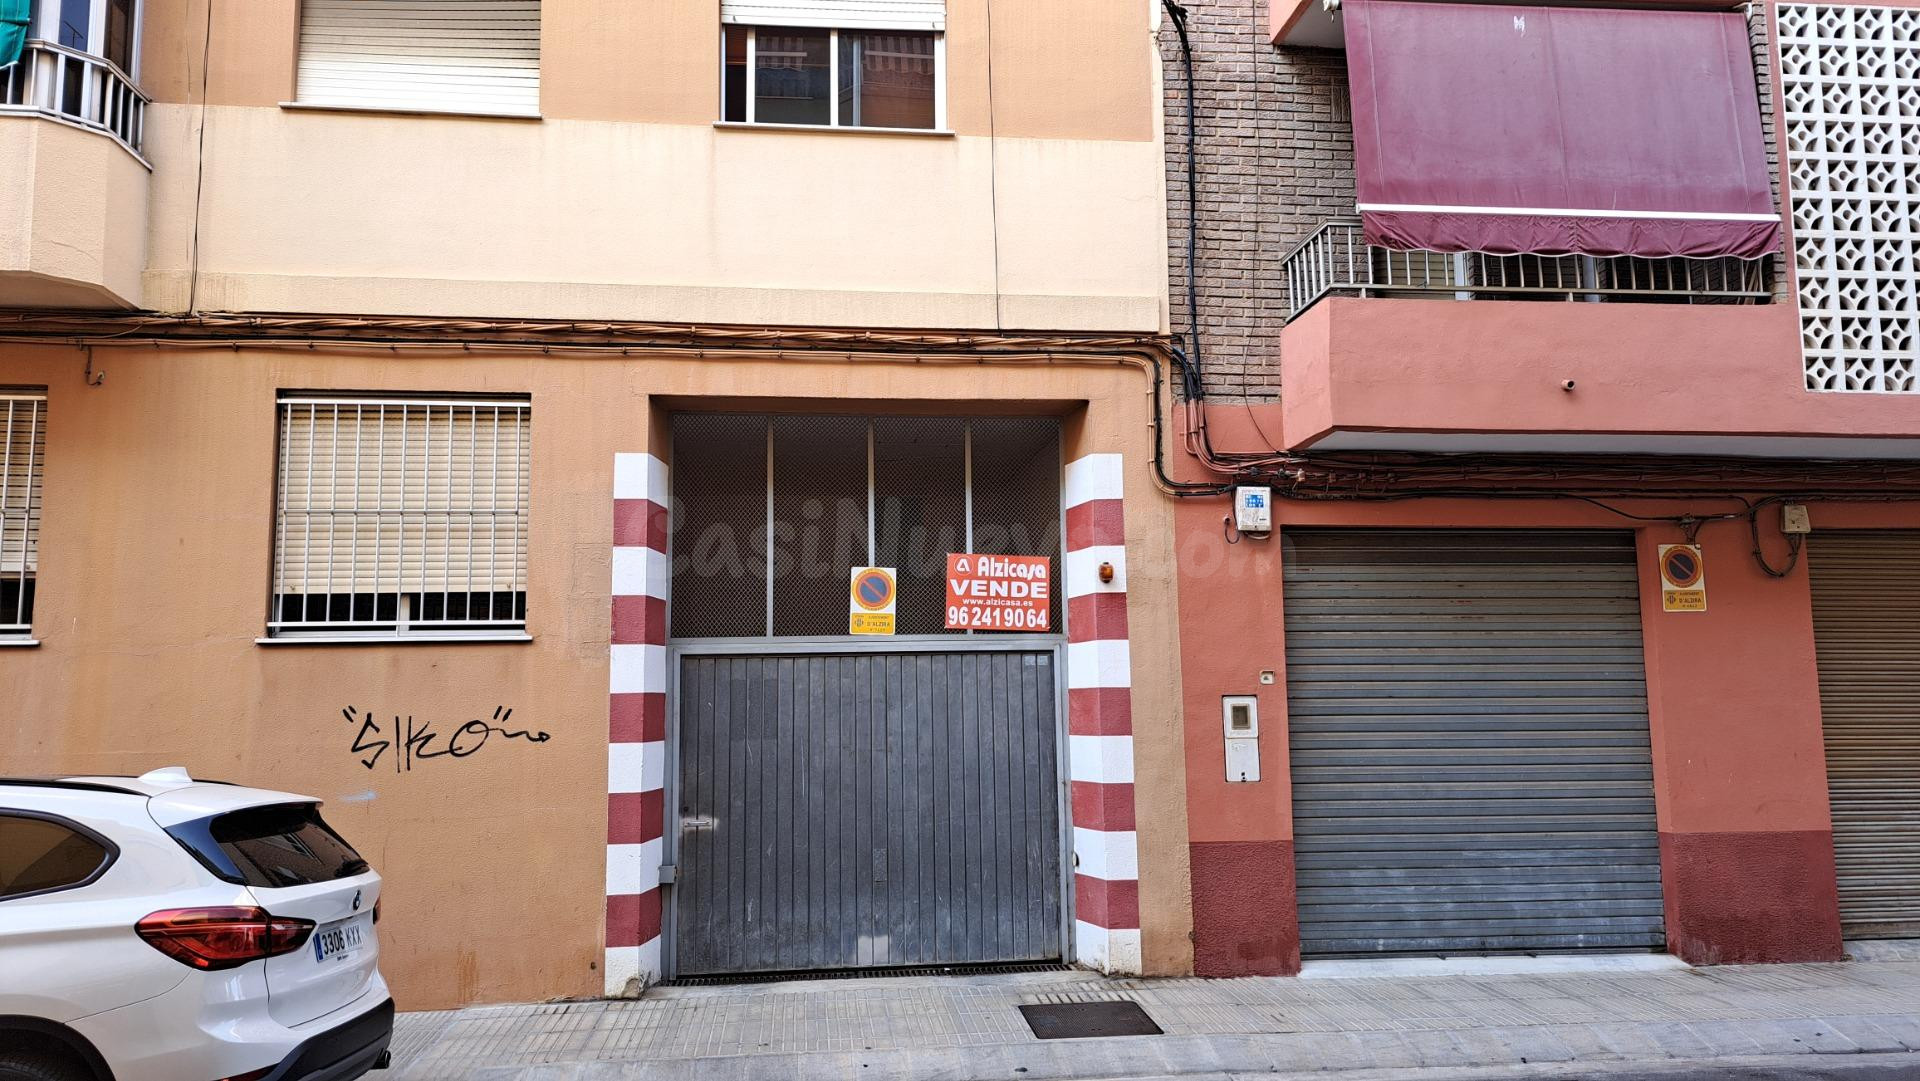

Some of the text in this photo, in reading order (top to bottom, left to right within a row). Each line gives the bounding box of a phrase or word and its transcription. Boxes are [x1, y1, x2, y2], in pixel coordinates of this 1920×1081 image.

[977, 556, 1047, 580] Alzicasa
[950, 579, 1048, 598] VENDE
[962, 598, 1033, 607] www.alzicasa.es
[321, 924, 363, 955] 3306 KXX
